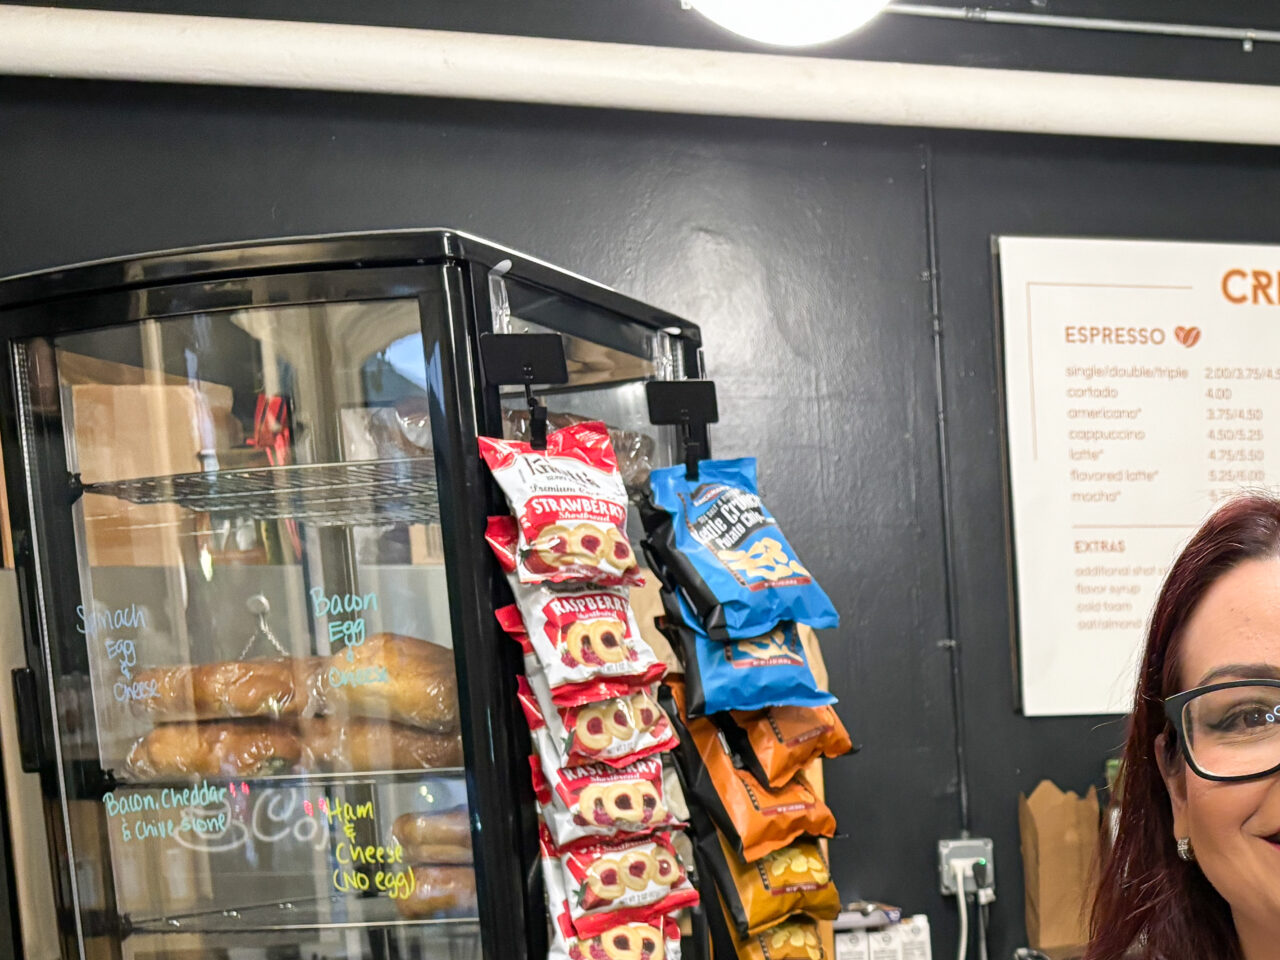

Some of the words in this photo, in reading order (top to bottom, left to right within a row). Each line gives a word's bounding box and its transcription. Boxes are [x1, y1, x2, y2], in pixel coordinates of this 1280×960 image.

[1065, 326, 1165, 345] ESPRESSO
[1066, 363, 1189, 381] single/double/triple
[1066, 386, 1118, 399] cortado
[1205, 388, 1232, 400] 4.00
[1068, 429, 1146, 442] cappuccino
[531, 498, 624, 520] STRAWBERRY
[1074, 541, 1125, 554] EXTRAS
[310, 586, 378, 617] Bacon
[550, 595, 629, 615] RASPBERRY
[328, 619, 365, 646] Egg
[104, 639, 137, 667] Egg
[112, 679, 161, 702] Cheese
[161, 780, 227, 810] Cheddar
[327, 797, 374, 825] Ham
[135, 816, 174, 841] Chive
[335, 842, 404, 865] Cheese
[375, 866, 416, 899] egg)
